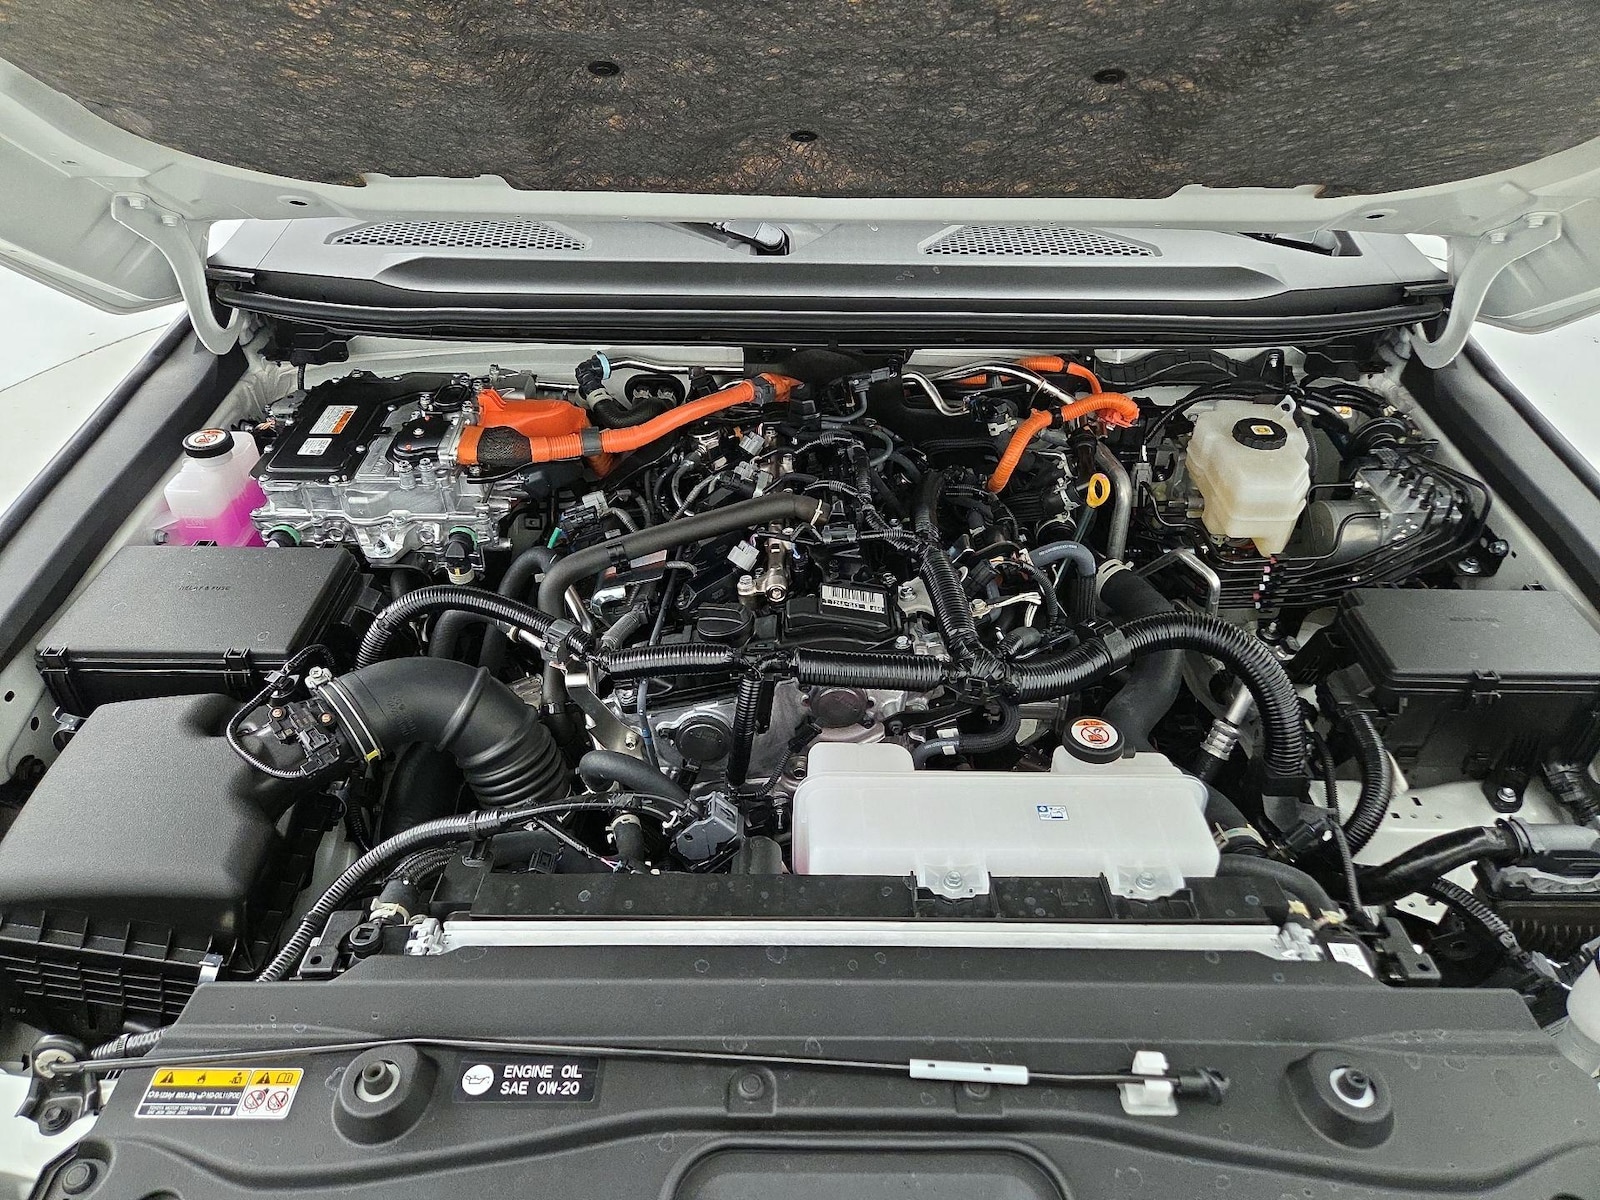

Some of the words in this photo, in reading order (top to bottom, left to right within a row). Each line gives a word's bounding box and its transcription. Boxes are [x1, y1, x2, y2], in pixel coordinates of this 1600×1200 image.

[503, 1065, 554, 1078] ENGINE
[561, 1065, 582, 1078] OIL
[500, 1081, 529, 1095] SAE
[536, 1081, 580, 1095] 0W-20
